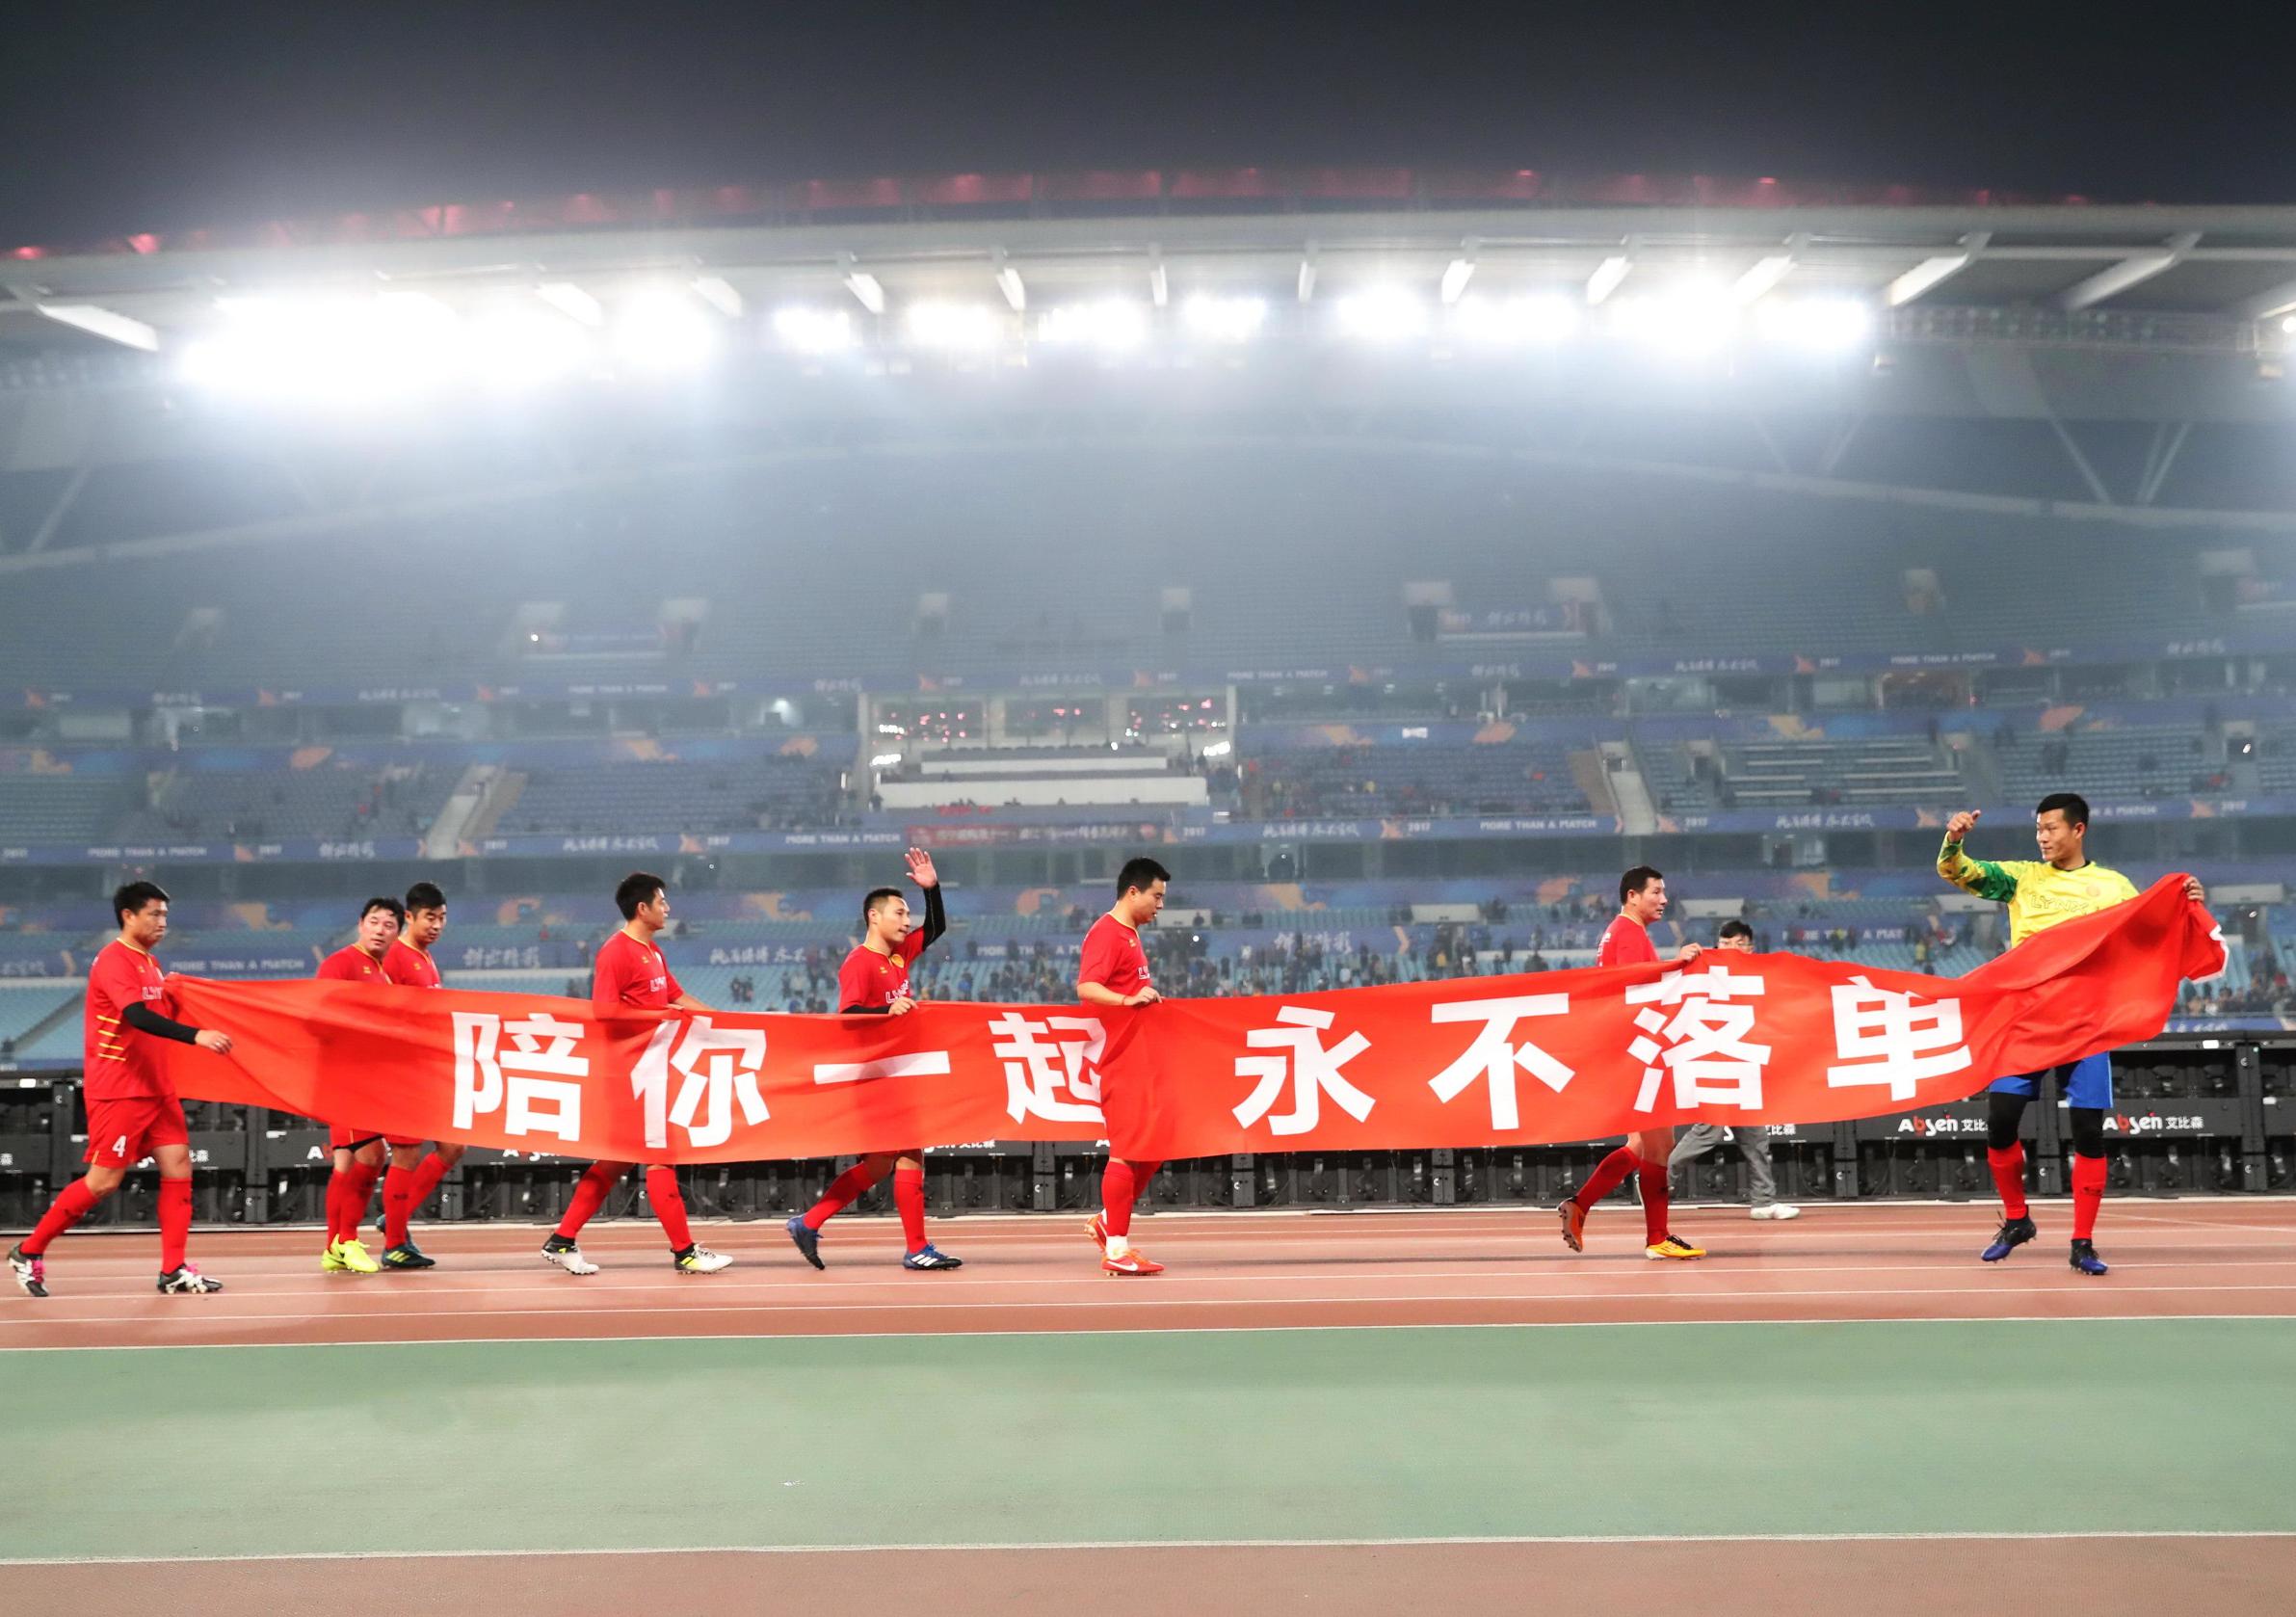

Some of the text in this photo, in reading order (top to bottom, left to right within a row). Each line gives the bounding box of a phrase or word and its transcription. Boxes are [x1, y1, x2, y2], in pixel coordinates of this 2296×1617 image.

[1897, 1114, 1959, 1136] Absen
[2101, 1111, 2163, 1135] Absen
[112, 1135, 127, 1158] 4
